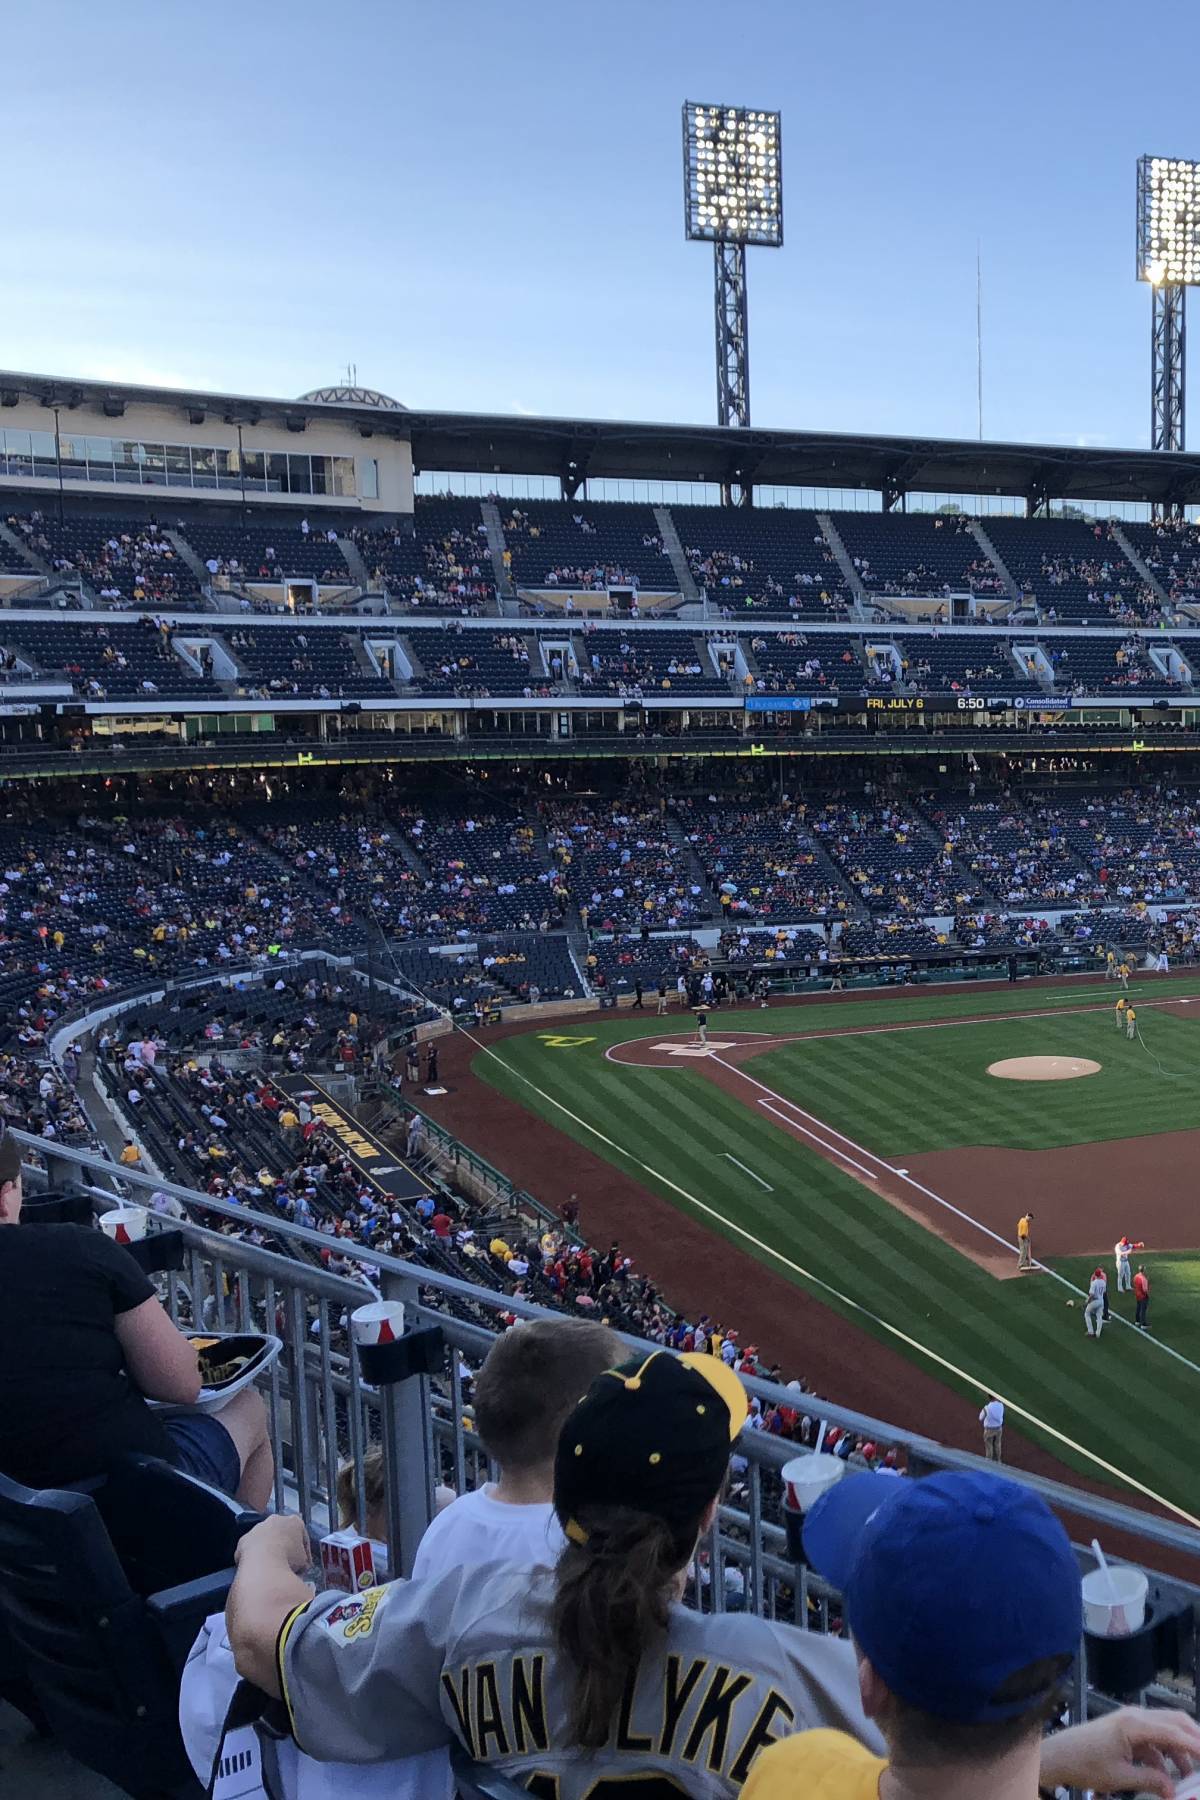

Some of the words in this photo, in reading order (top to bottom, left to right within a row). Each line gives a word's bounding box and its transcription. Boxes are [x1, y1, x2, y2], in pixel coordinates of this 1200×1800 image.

[867, 699, 886, 709] FRI,
[888, 699, 914, 708] JULY
[916, 699, 924, 708] 6
[957, 698, 984, 709] 6:50
[441, 1654, 551, 1760] VAN
[612, 1653, 796, 1786] LYKE
